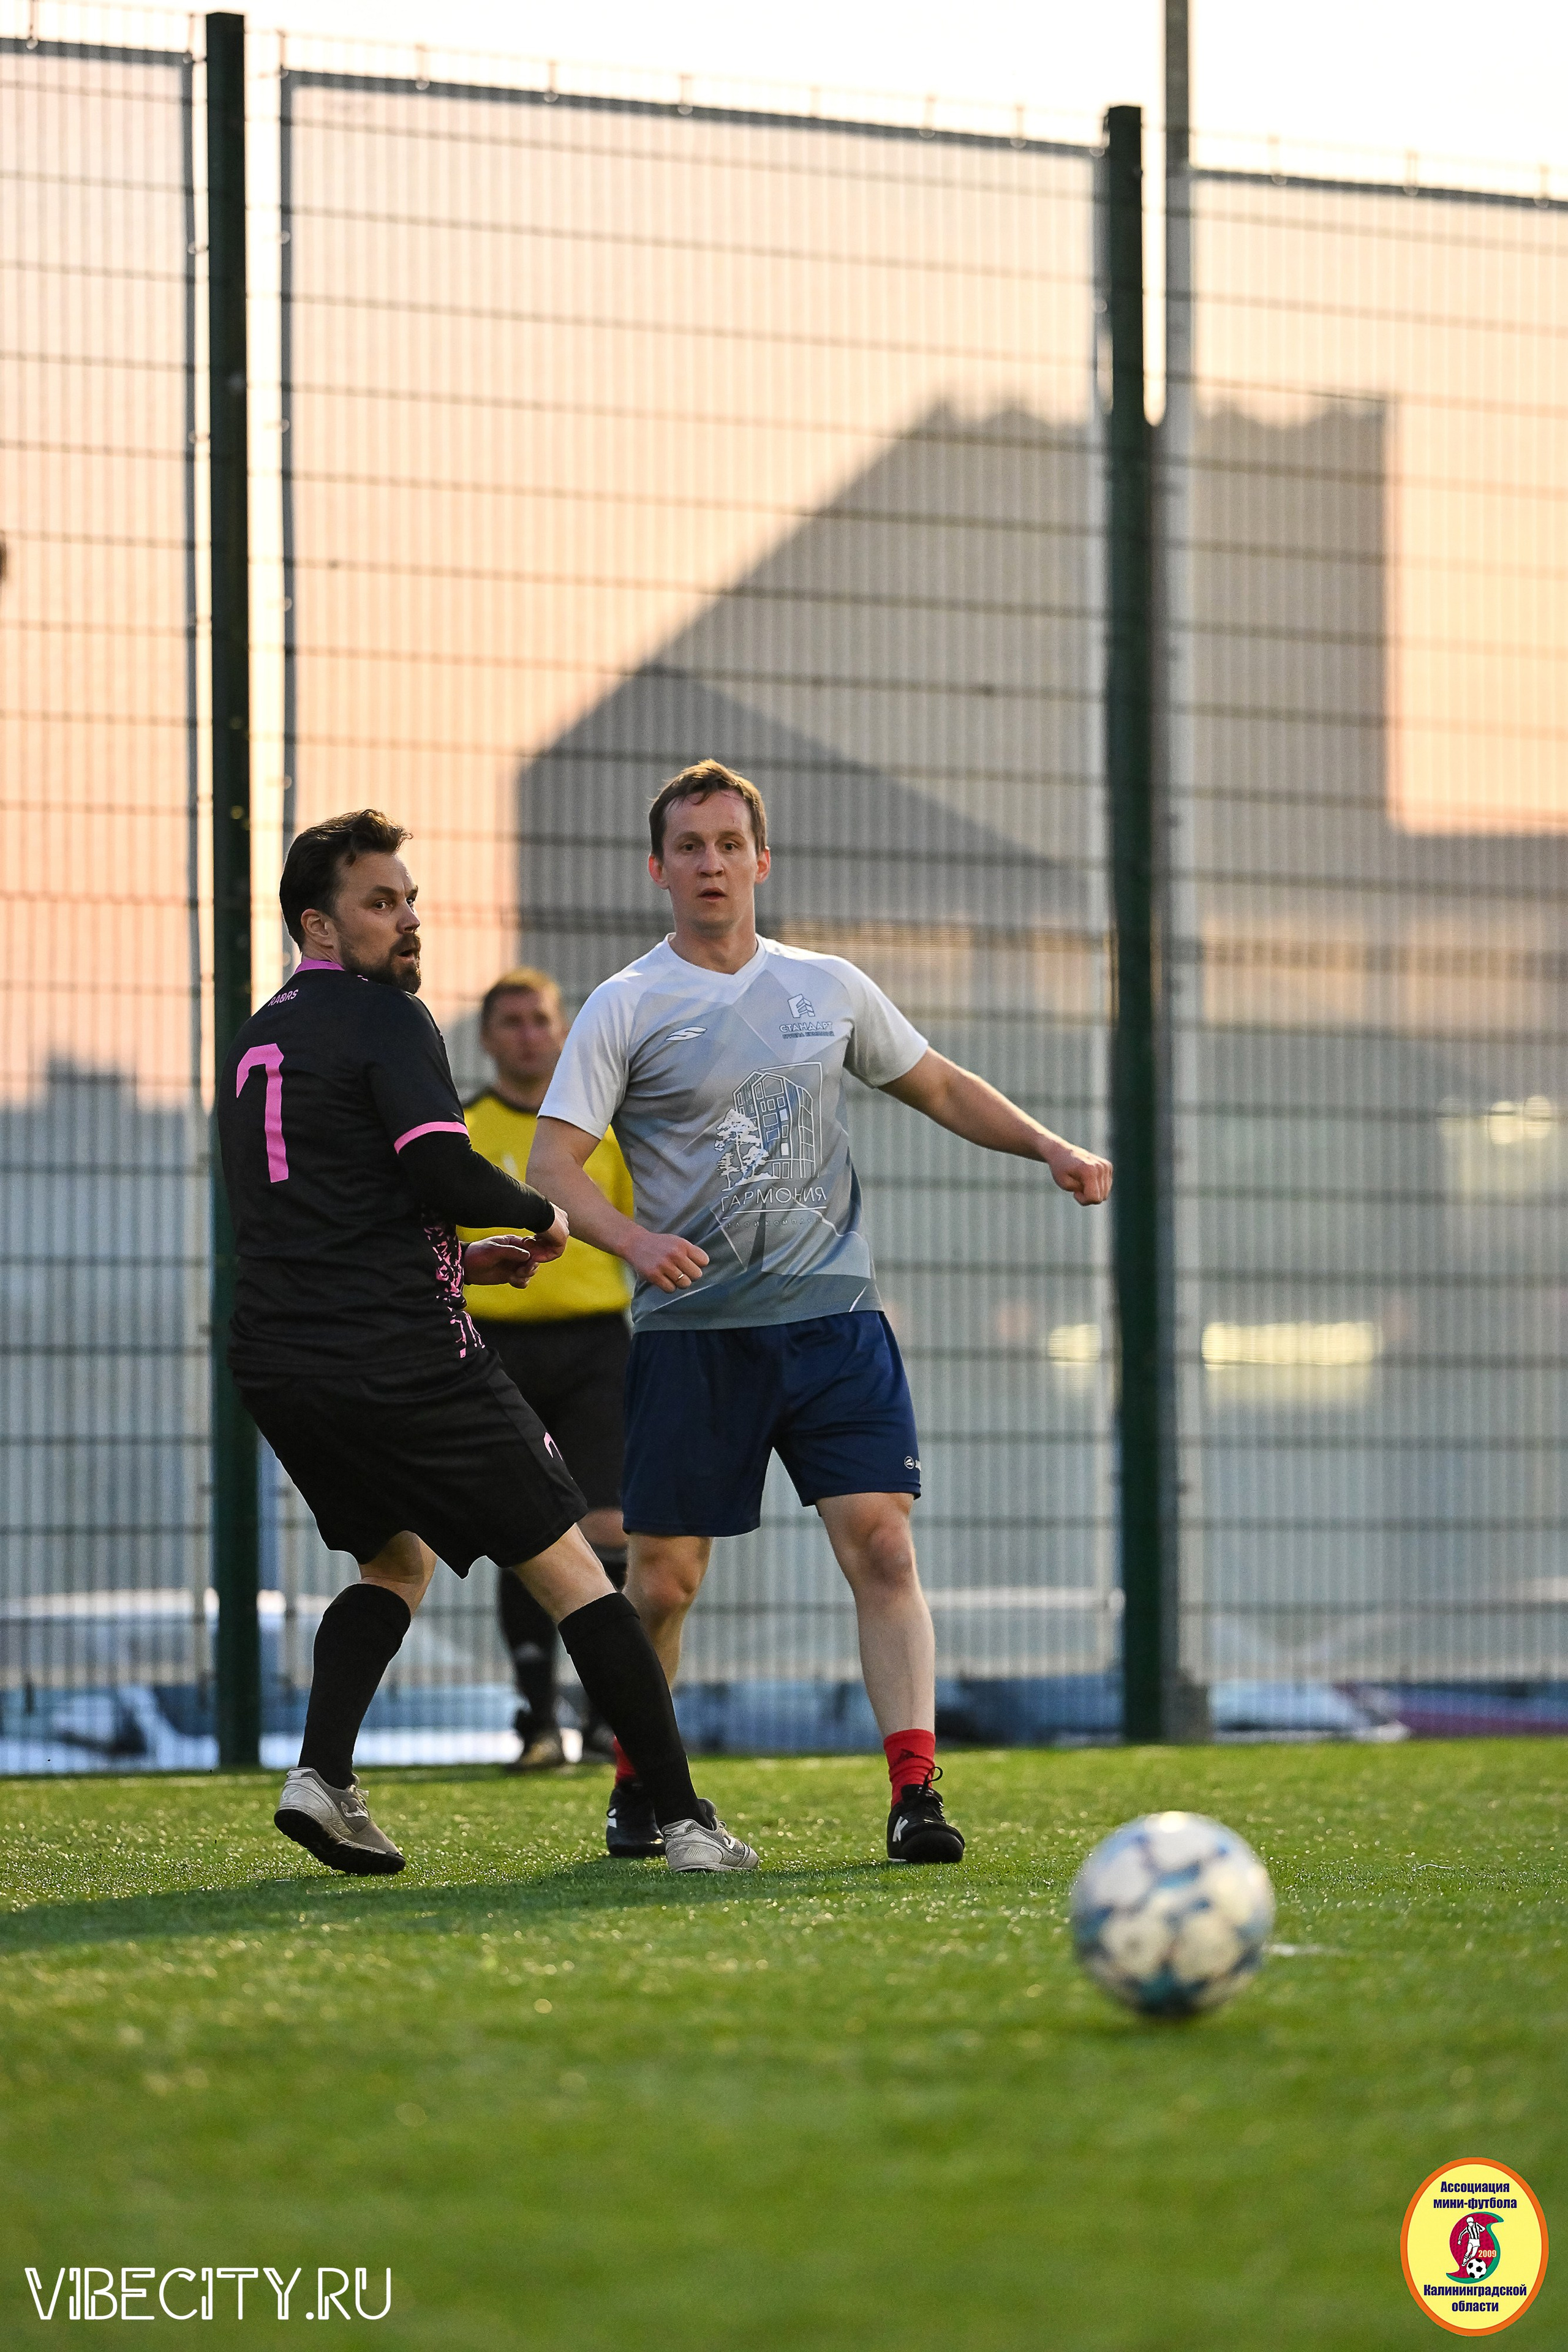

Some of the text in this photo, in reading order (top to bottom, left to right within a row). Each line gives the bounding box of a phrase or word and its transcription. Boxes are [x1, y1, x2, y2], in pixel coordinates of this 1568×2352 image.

[779, 1021, 832, 1033] СТАНДАРТ
[236, 1042, 289, 1183] 7
[720, 1186, 827, 1212] ГАРМОНИЯ
